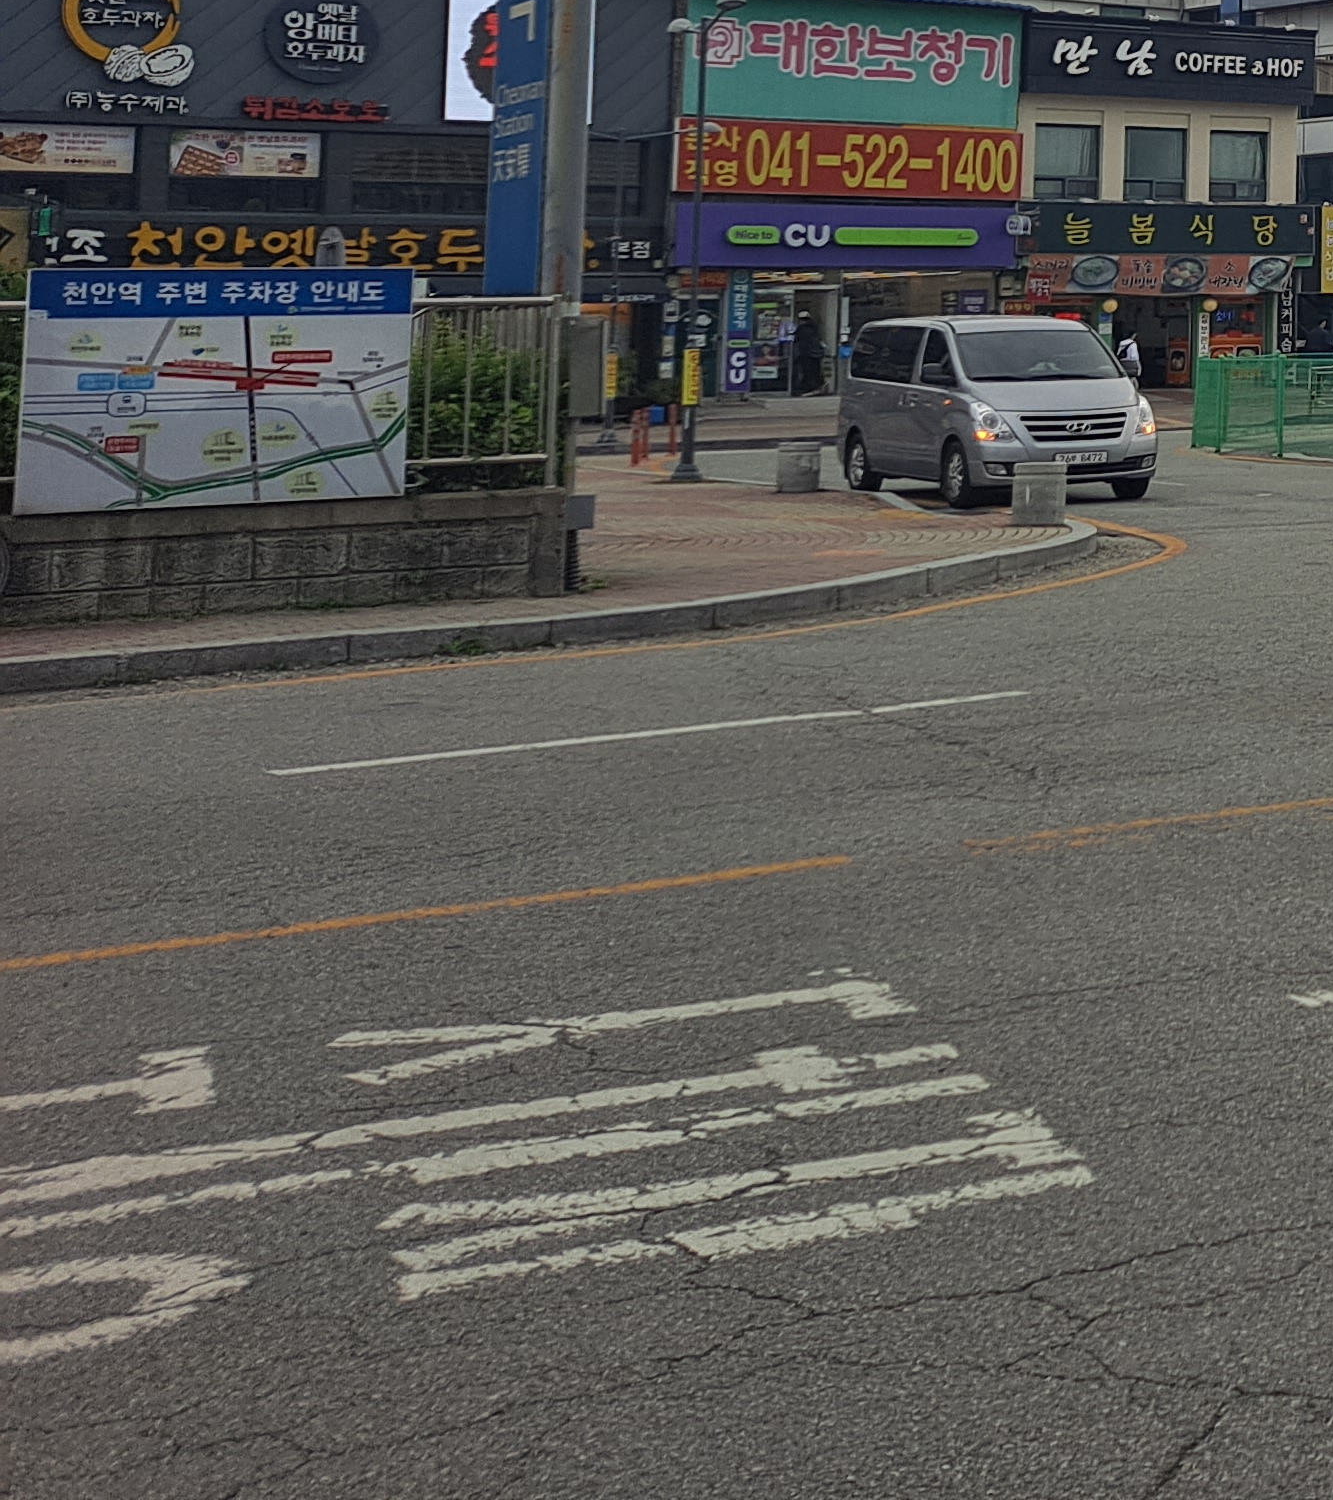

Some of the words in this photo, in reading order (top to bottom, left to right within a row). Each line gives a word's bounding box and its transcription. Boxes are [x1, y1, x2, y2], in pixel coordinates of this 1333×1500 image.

[317, 2, 359, 23] 옛날
[284, 43, 367, 64] 호두과자
[748, 19, 1014, 88] 대한보청기
[1175, 51, 1248, 77] COFFEE
[1267, 57, 1304, 79] HOF
[494, 112, 534, 139] Station
[746, 128, 1018, 194] 041-522-1400
[784, 223, 831, 248] CU
[63, 281, 142, 307] 천안역
[157, 280, 207, 306] 주변
[220, 278, 300, 306] 주차장
[311, 279, 386, 304] 안내도
[729, 351, 747, 385] CU
